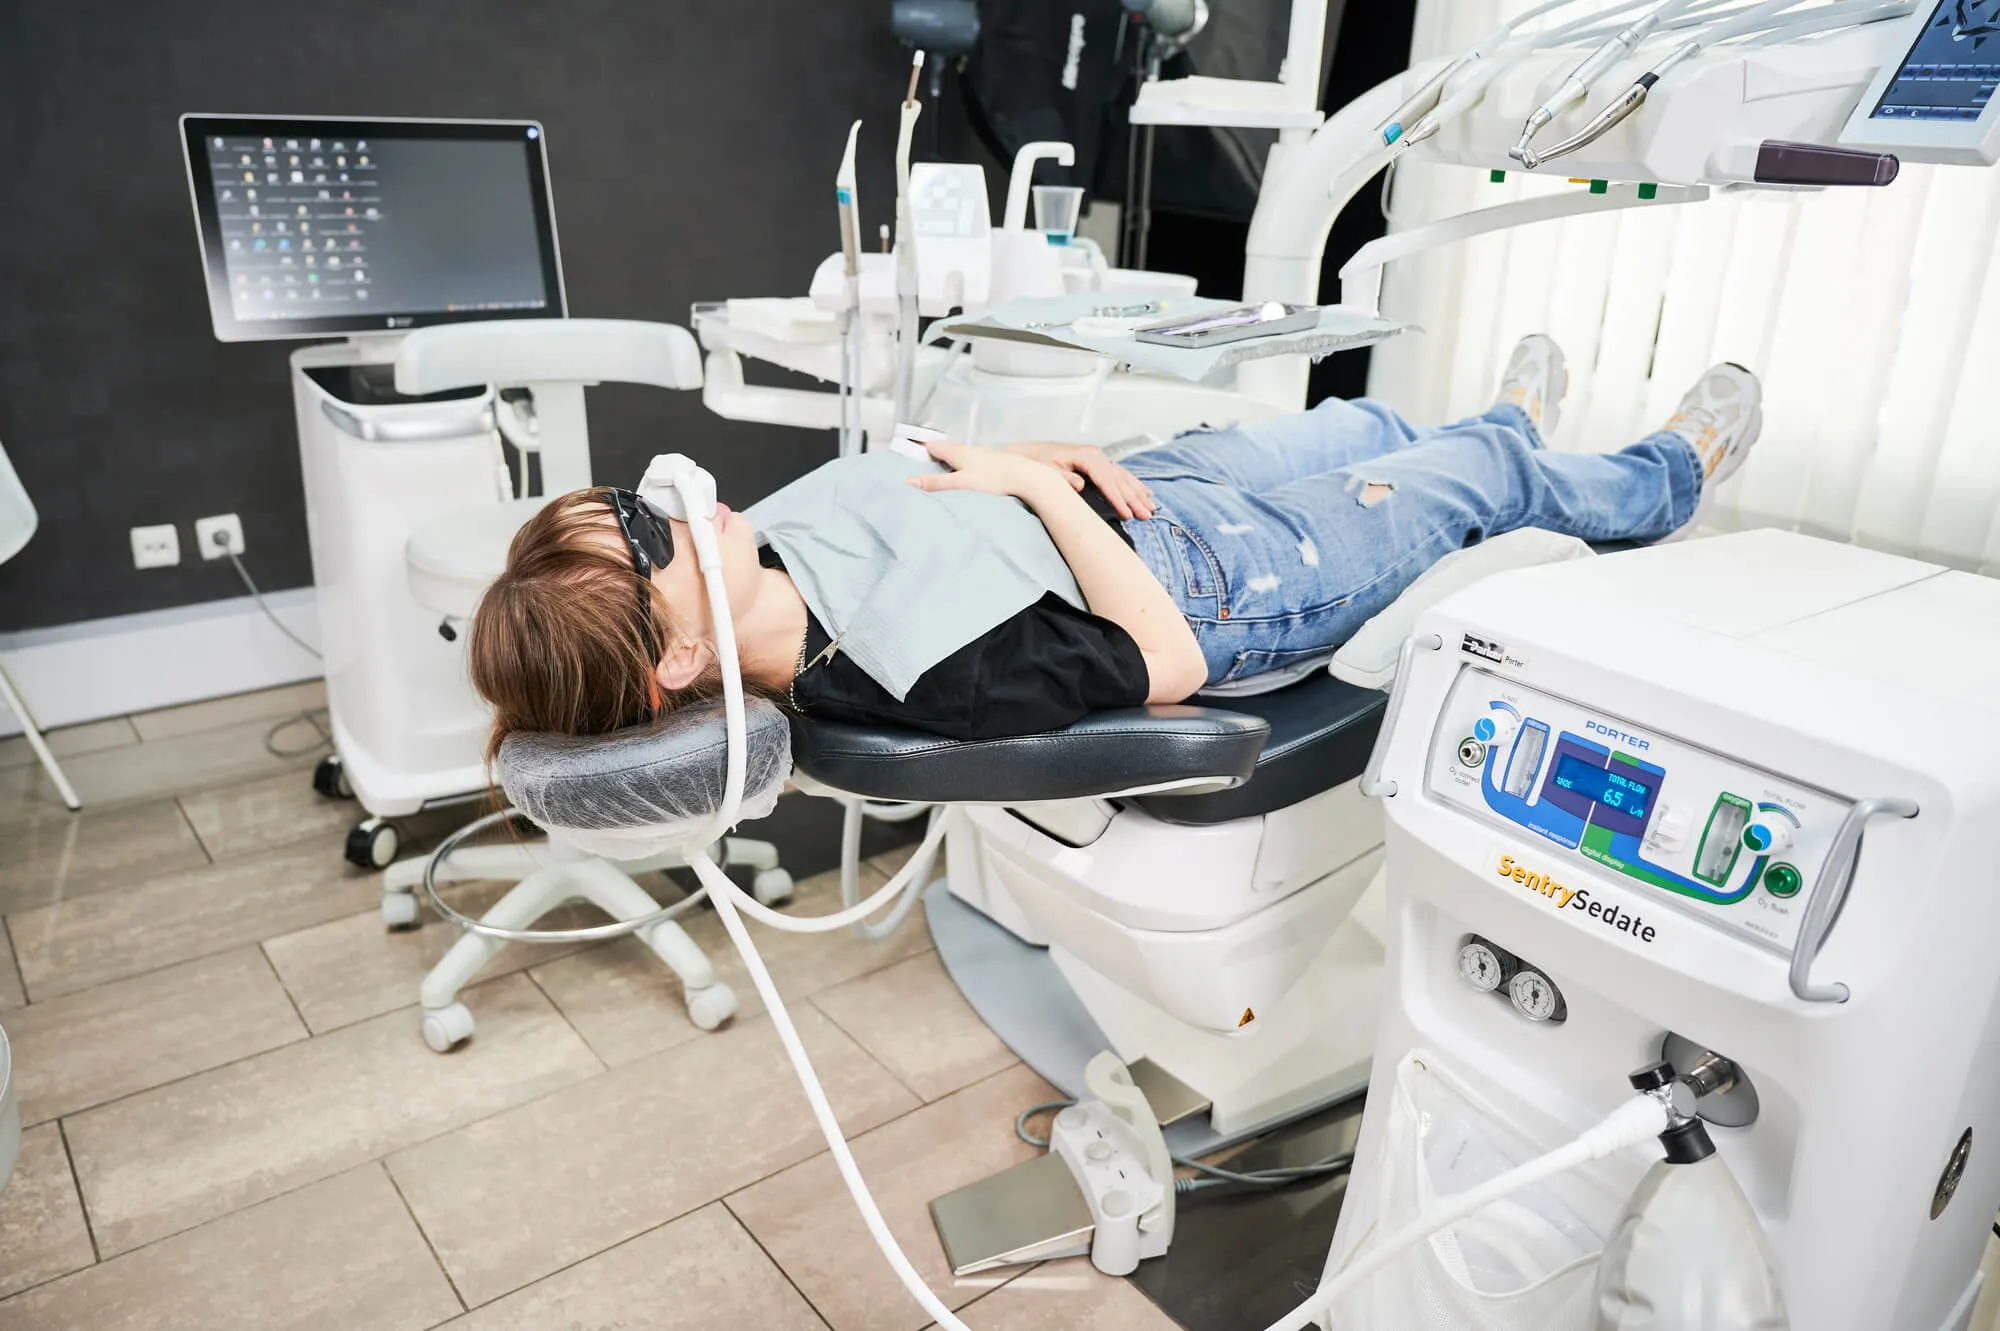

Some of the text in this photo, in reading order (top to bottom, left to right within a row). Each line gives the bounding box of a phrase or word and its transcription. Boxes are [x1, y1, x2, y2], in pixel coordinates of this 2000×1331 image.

[1505, 655, 1524, 668] Porter
[1585, 720, 1650, 751] PORTER
[1608, 772, 1646, 795] TOTAL FLOW
[1548, 830, 1578, 848] response
[1580, 845, 1625, 870] digital display
[1496, 855, 1656, 943] SentrySedate
